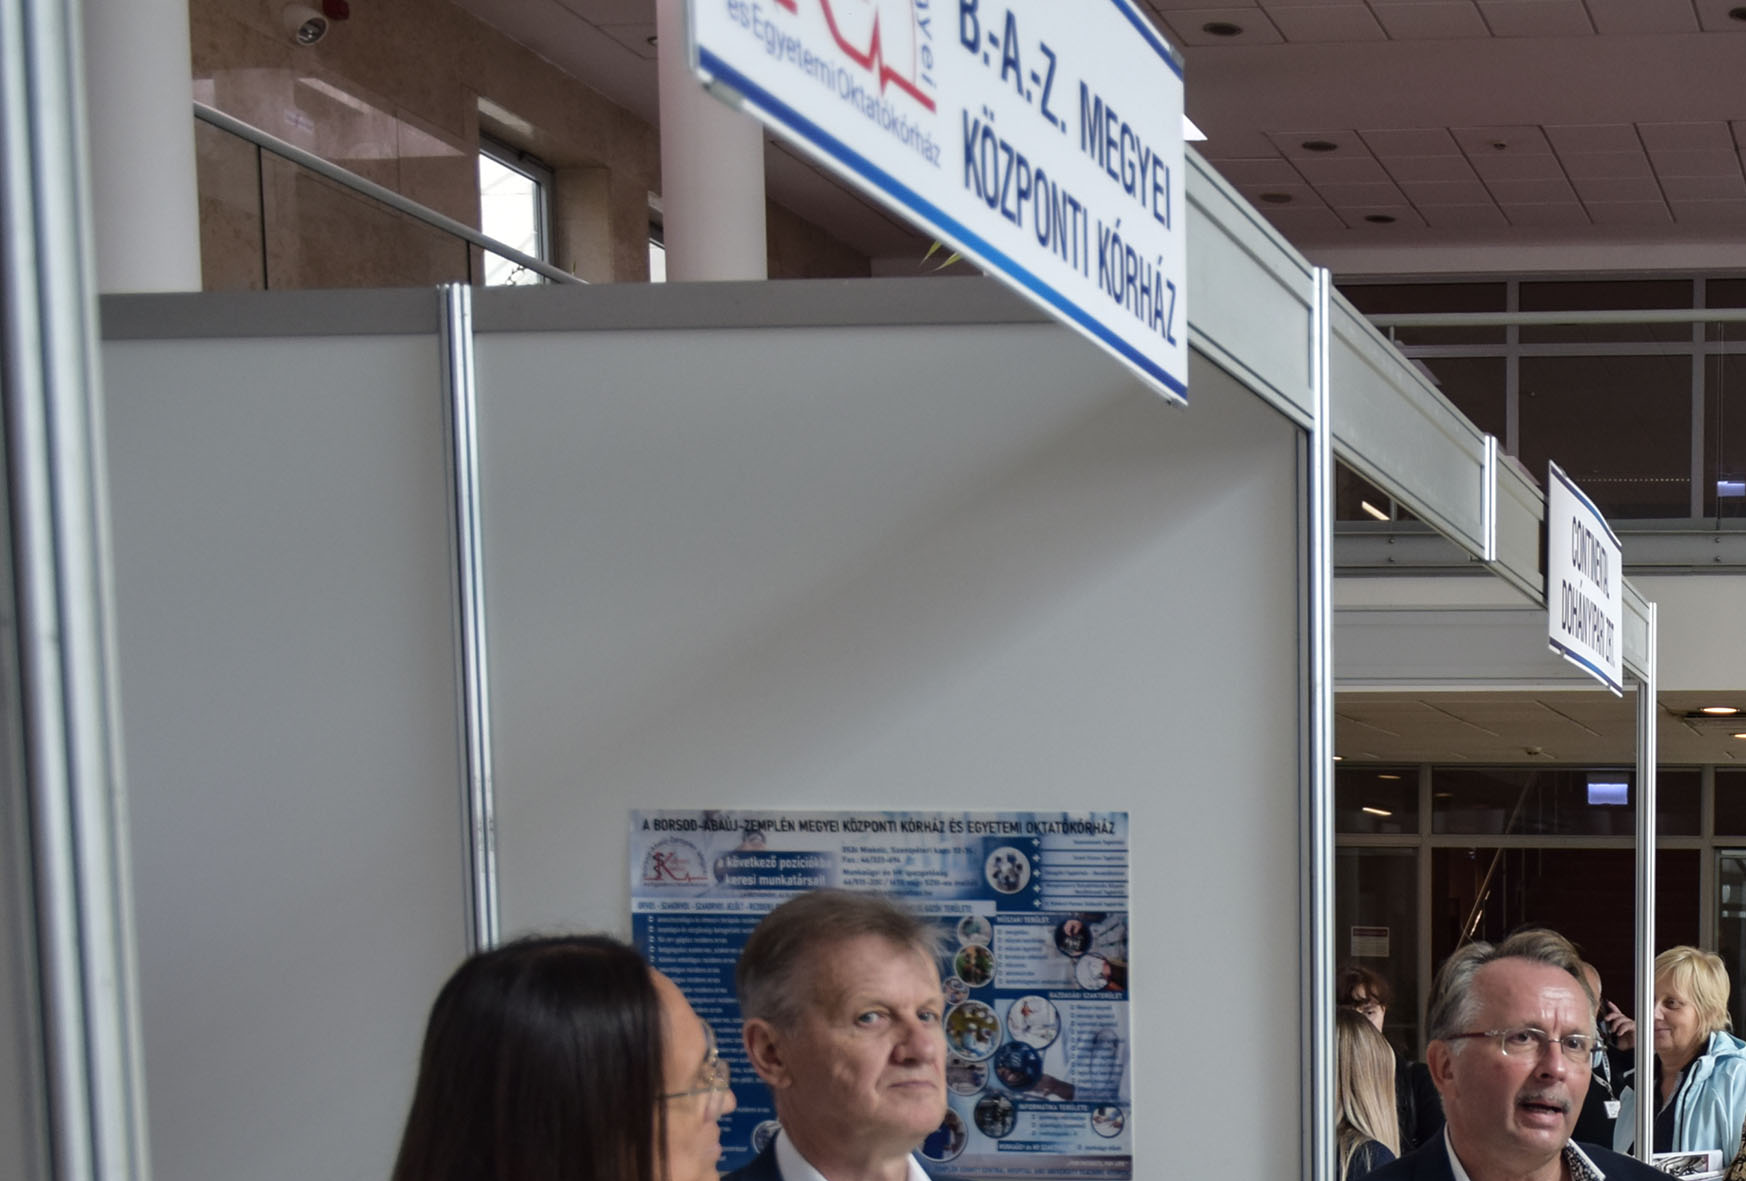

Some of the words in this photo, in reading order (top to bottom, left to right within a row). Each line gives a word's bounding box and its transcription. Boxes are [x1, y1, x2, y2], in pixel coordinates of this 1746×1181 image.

[1079, 79, 1171, 231] MEGYEI
[962, 104, 1089, 279] KÖZPONTI
[1098, 216, 1177, 348] KÓRHÁZ
[643, 819, 650, 831] A
[653, 816, 796, 832] BORSOD-ABAÚJ-ZEMPLÉN
[800, 820, 840, 832] MEGYEI
[843, 817, 898, 833] KÖZPONTI
[901, 818, 945, 833] KÓRHÁZ
[950, 818, 964, 833] ÉS
[967, 821, 1023, 834] EGYETEMI
[1026, 818, 1115, 835] OKTATÓKÓRHÁZ
[717, 859, 724, 868] a
[727, 855, 777, 868] következő
[725, 873, 756, 885] keresi
